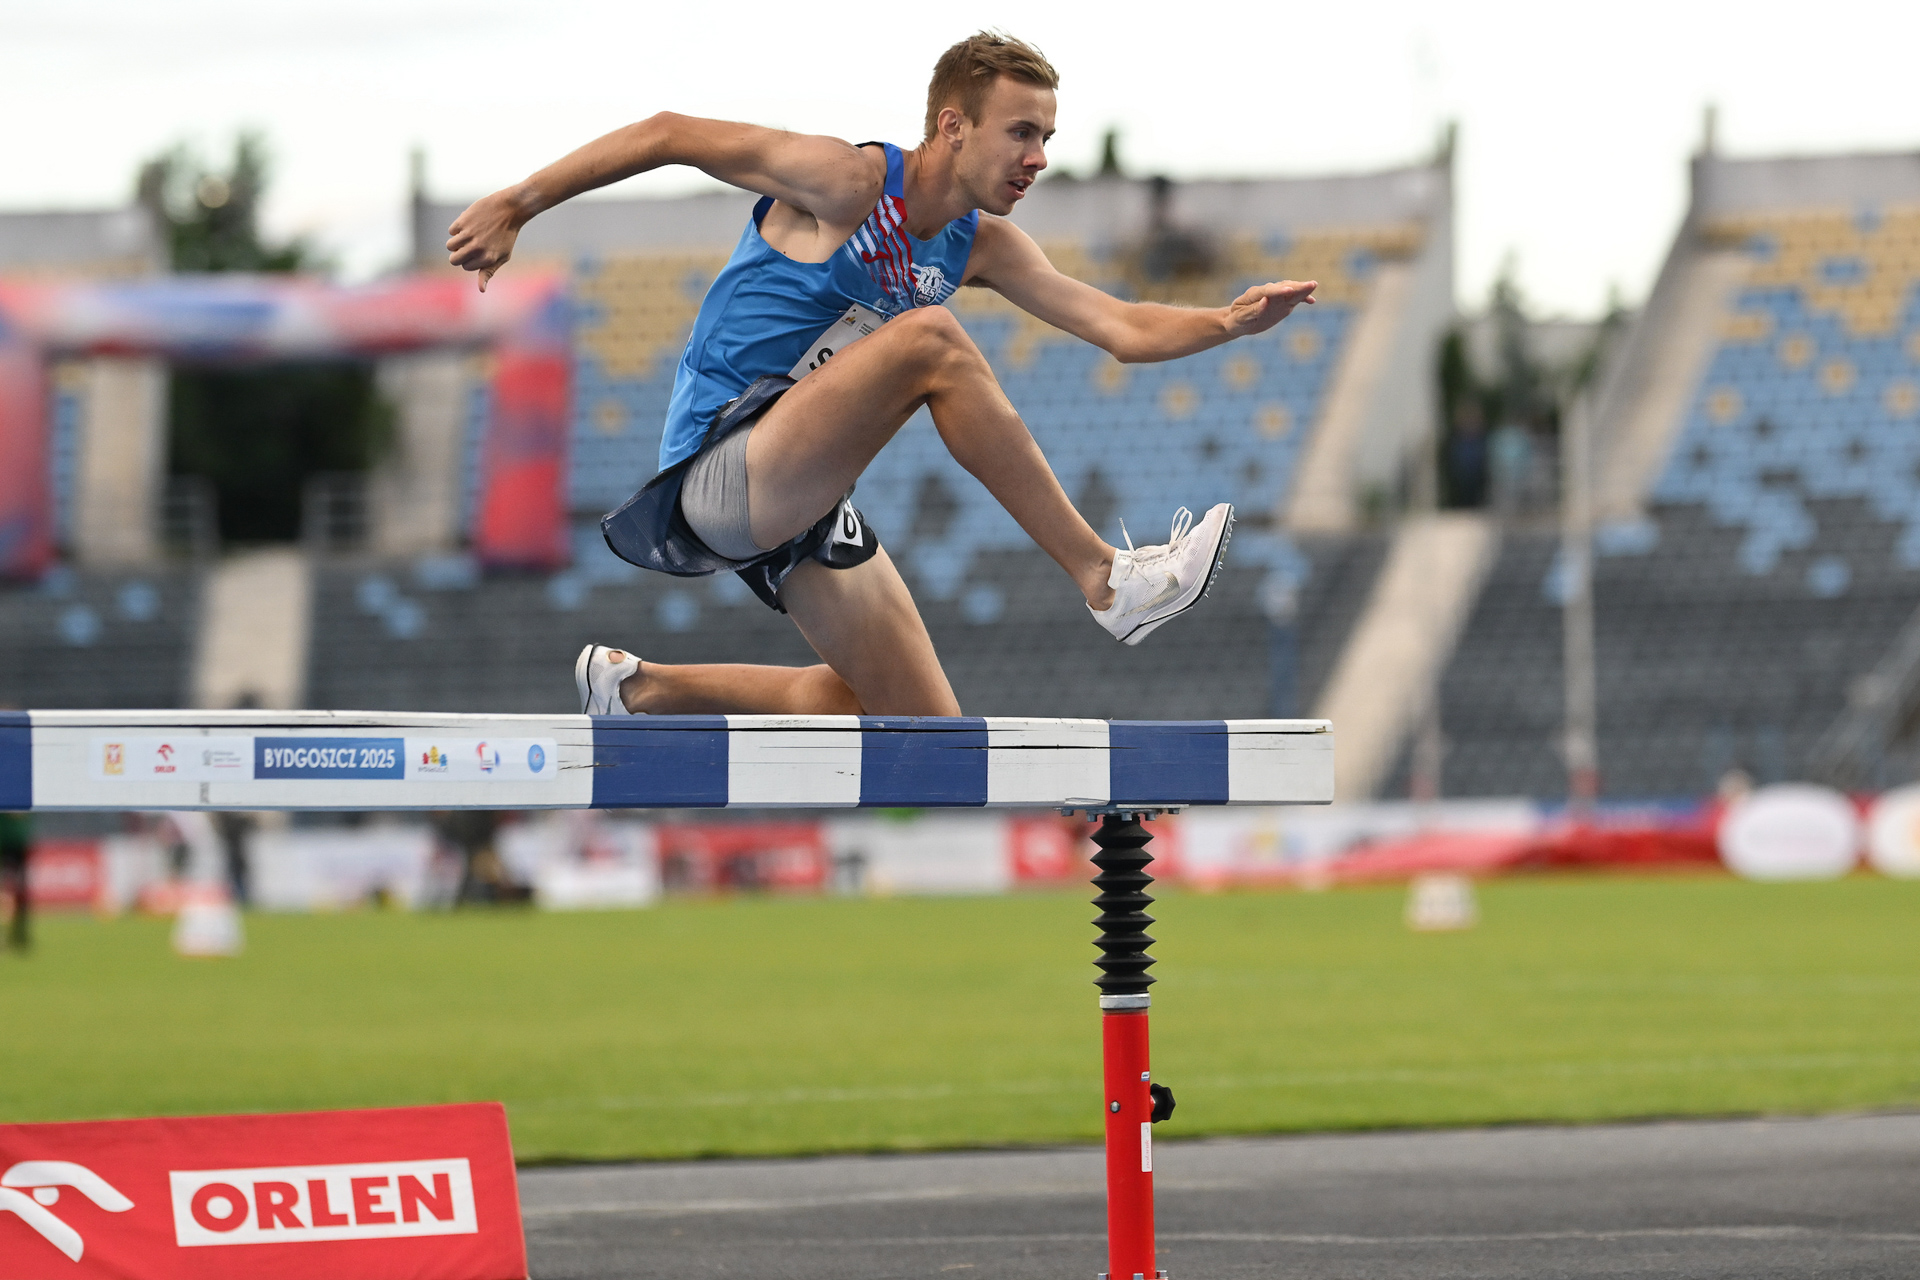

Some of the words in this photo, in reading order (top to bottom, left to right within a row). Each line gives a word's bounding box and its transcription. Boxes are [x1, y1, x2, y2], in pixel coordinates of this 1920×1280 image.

[919, 284, 936, 297] AZS
[264, 748, 357, 768] BYDGOSZCZ
[360, 748, 396, 768] 2025
[191, 1173, 455, 1232] ORLEN
